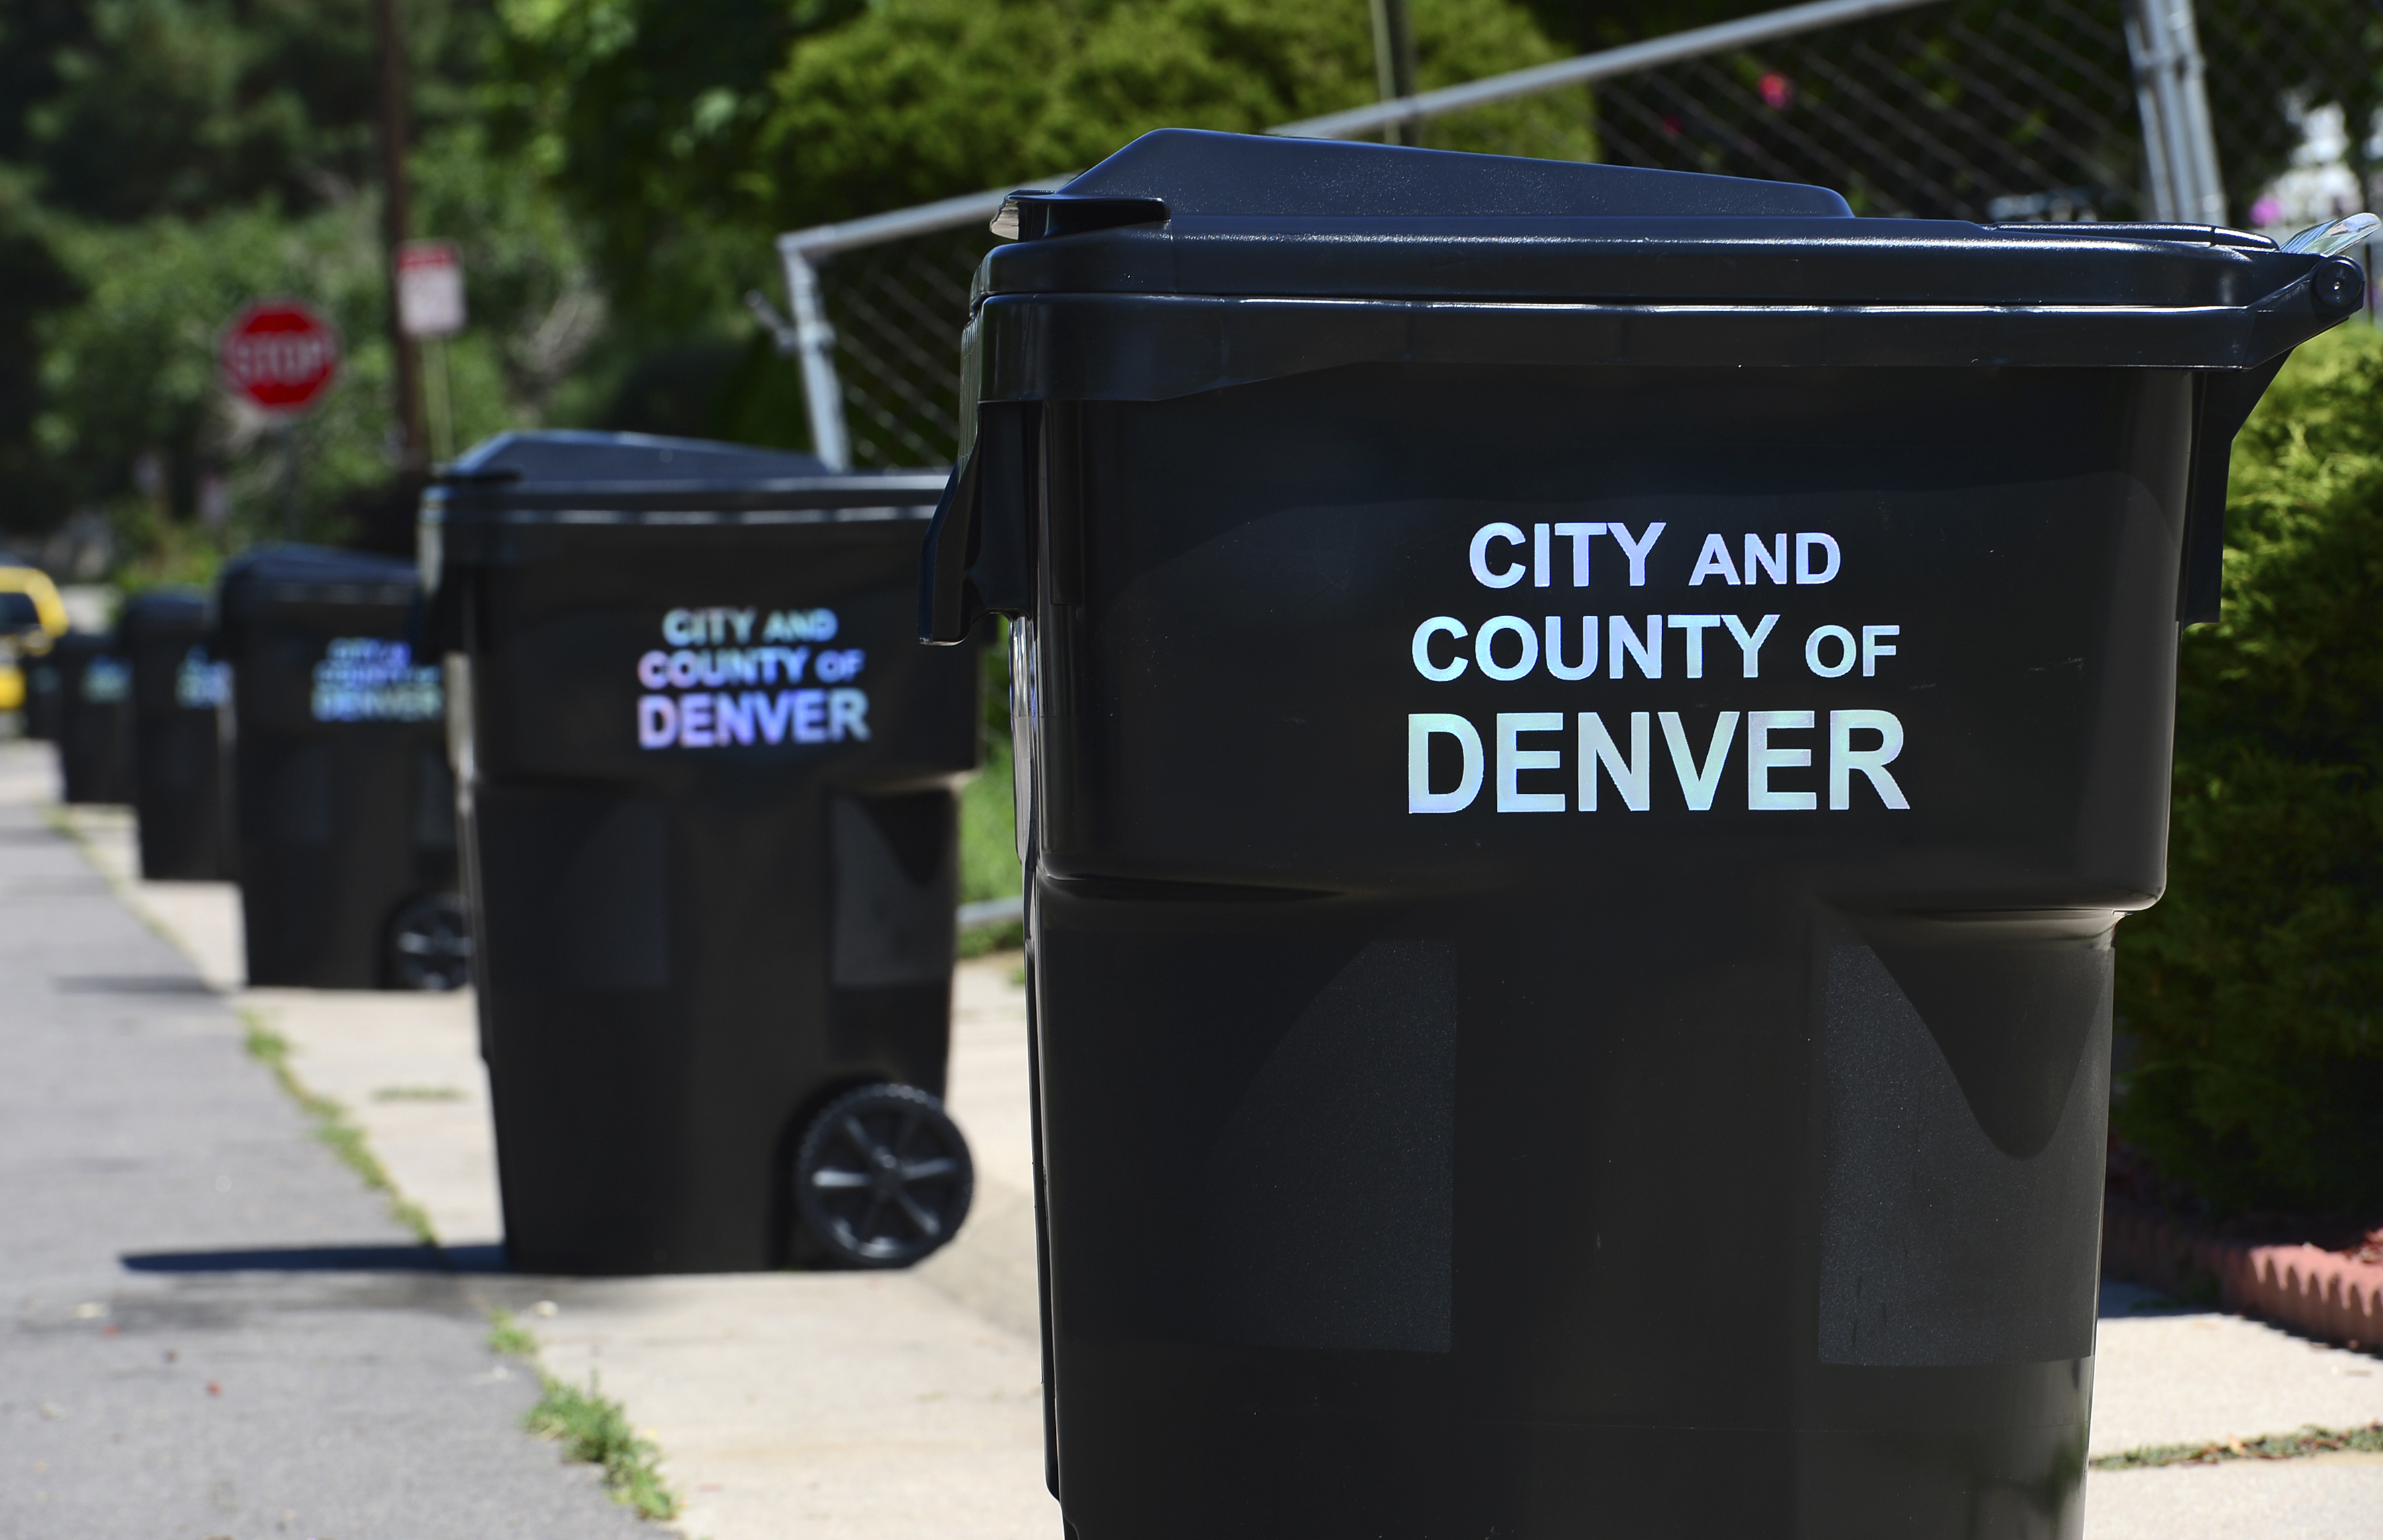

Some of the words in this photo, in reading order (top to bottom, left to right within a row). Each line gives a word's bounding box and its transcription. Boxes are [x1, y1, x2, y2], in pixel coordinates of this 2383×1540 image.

[229, 333, 328, 382] STOP
[1469, 522, 1667, 588] CITY
[1688, 532, 1841, 586] AND
[662, 606, 756, 647] CITY
[762, 608, 839, 643] AND
[1411, 614, 1781, 681] COUNTY
[1805, 625, 1900, 678] OF
[637, 646, 811, 690] COUNTY
[814, 648, 866, 683] OF
[637, 687, 871, 749] DENVER
[1408, 710, 1911, 814] DENVER
